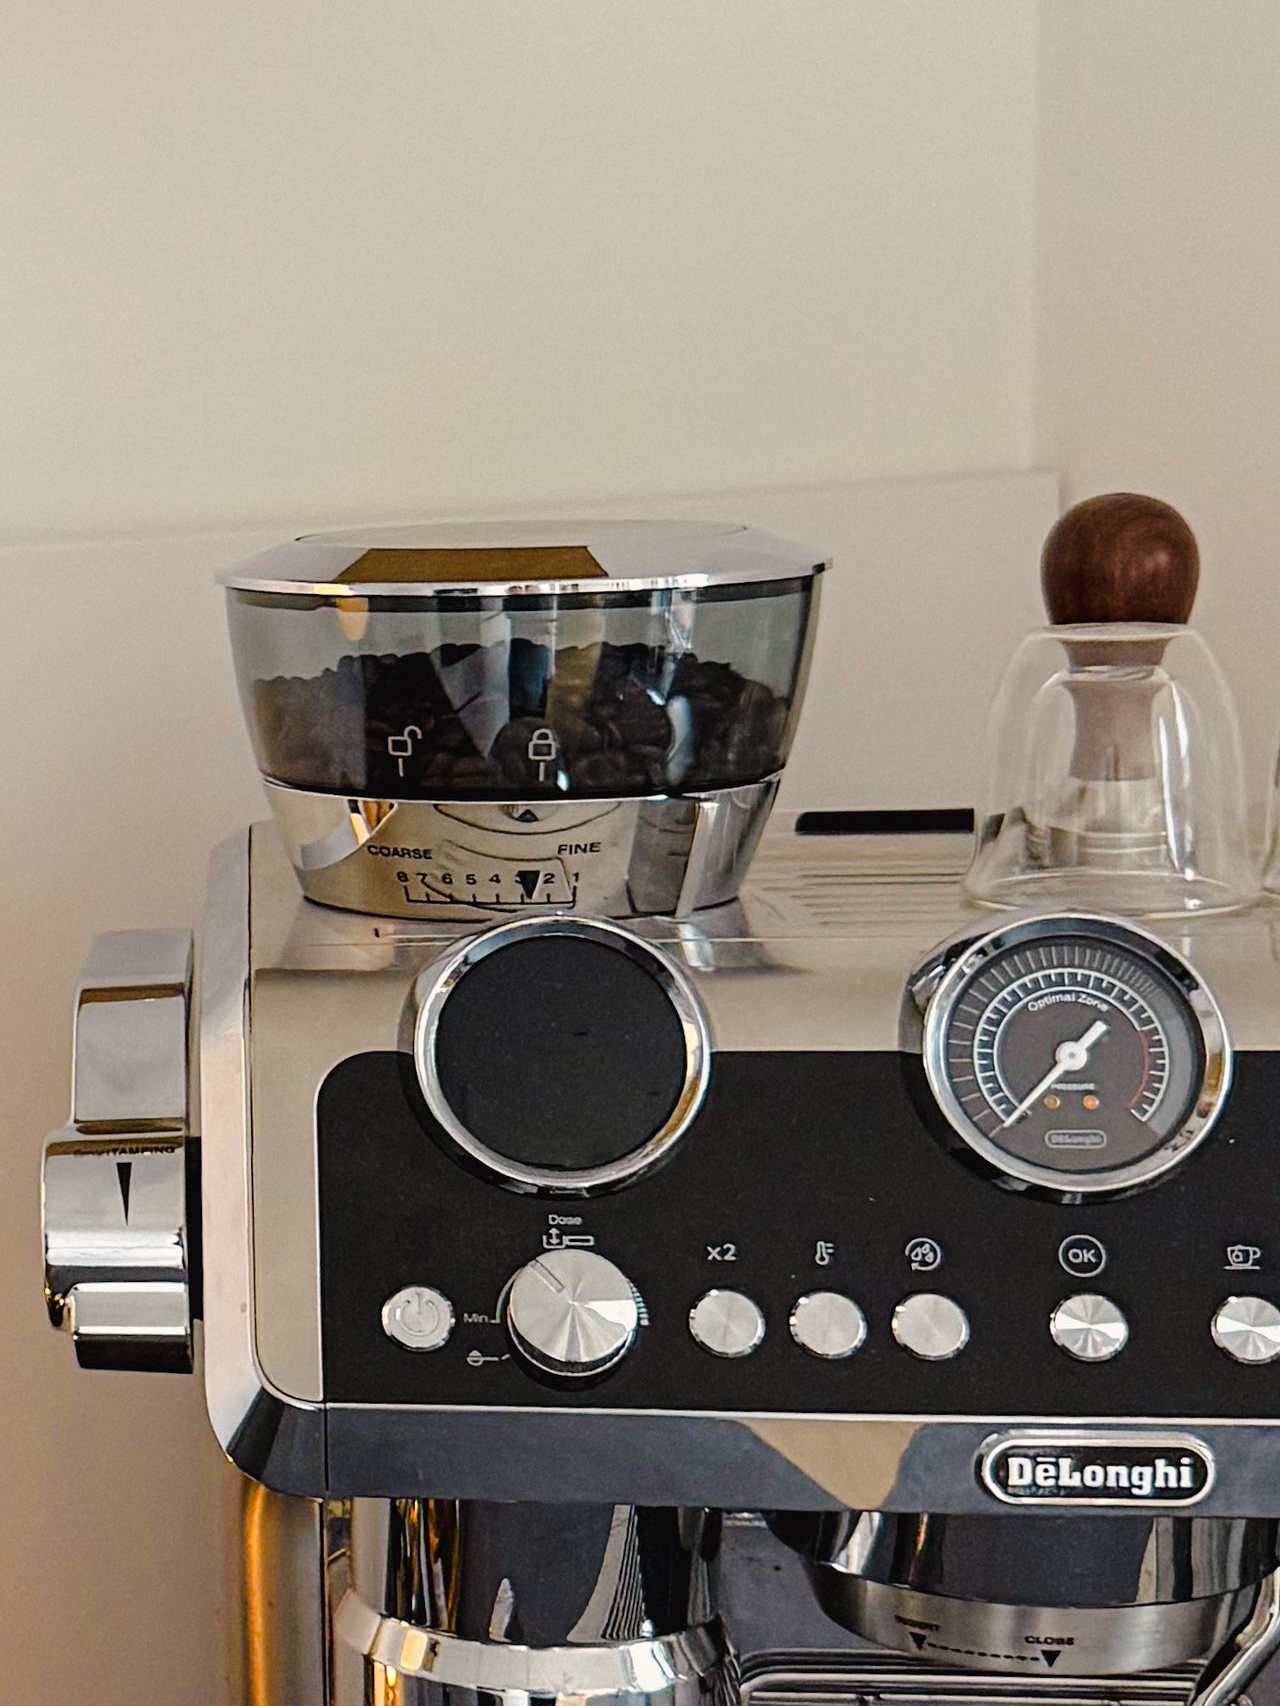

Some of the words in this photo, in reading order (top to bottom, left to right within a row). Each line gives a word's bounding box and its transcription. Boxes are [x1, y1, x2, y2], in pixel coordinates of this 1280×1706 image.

[367, 845, 432, 860] COARSE
[557, 842, 602, 855] FINE
[443, 873, 453, 885] 6
[466, 874, 477, 885] 5
[490, 873, 501, 884] 4
[543, 873, 555, 884] 2
[573, 872, 580, 883] 1
[1027, 992, 1076, 1011] Optimal
[548, 1214, 583, 1225] Dose
[707, 1244, 737, 1261] x2
[1068, 1248, 1096, 1263] OK
[463, 1313, 488, 1324] Min
[1025, 1635, 1074, 1645] CLOSE
